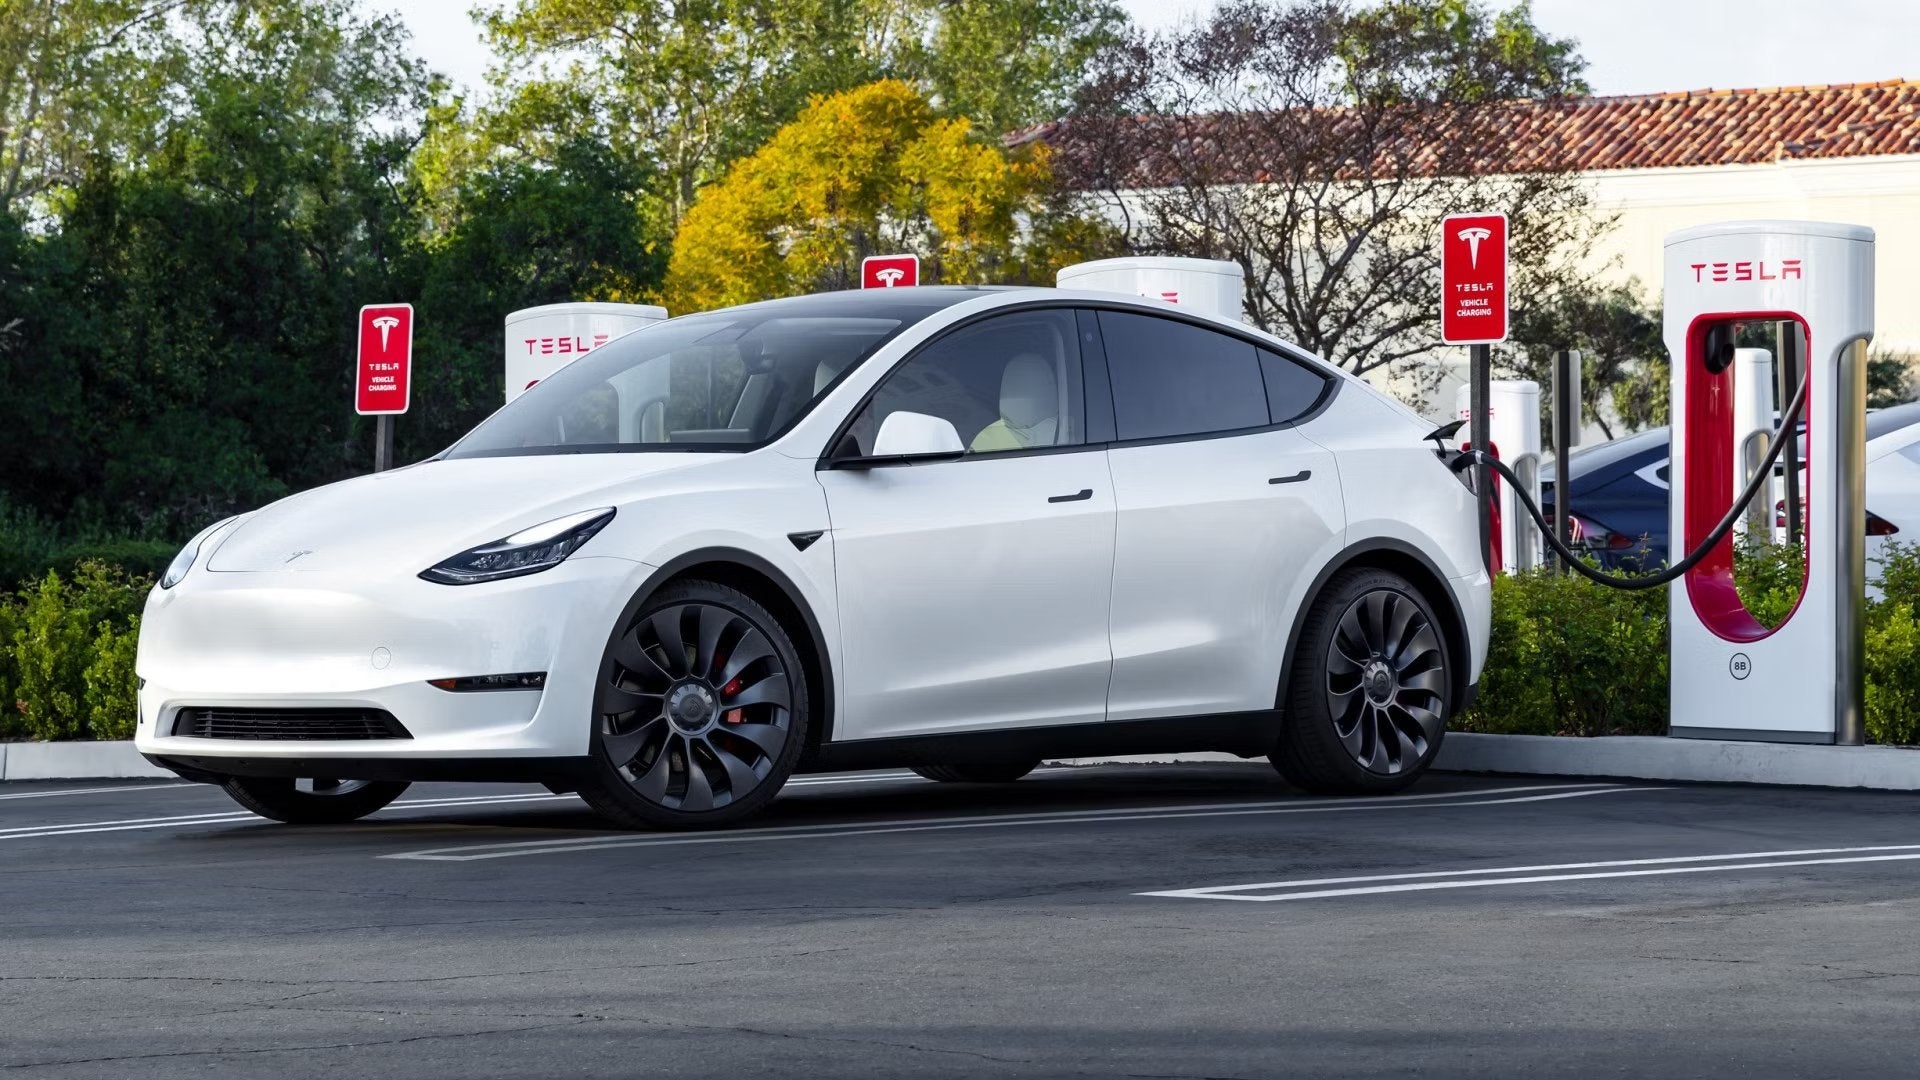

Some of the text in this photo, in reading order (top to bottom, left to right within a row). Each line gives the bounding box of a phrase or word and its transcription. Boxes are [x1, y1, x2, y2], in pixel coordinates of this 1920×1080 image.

[1690, 259, 1801, 283] TESLA
[1456, 283, 1494, 292] TESLA
[1460, 299, 1489, 307] VEHICLE
[1456, 308, 1492, 317] CHARGING
[368, 363, 399, 371] TESLA
[368, 384, 397, 392] CHARGING
[1734, 661, 1747, 671] 8B
